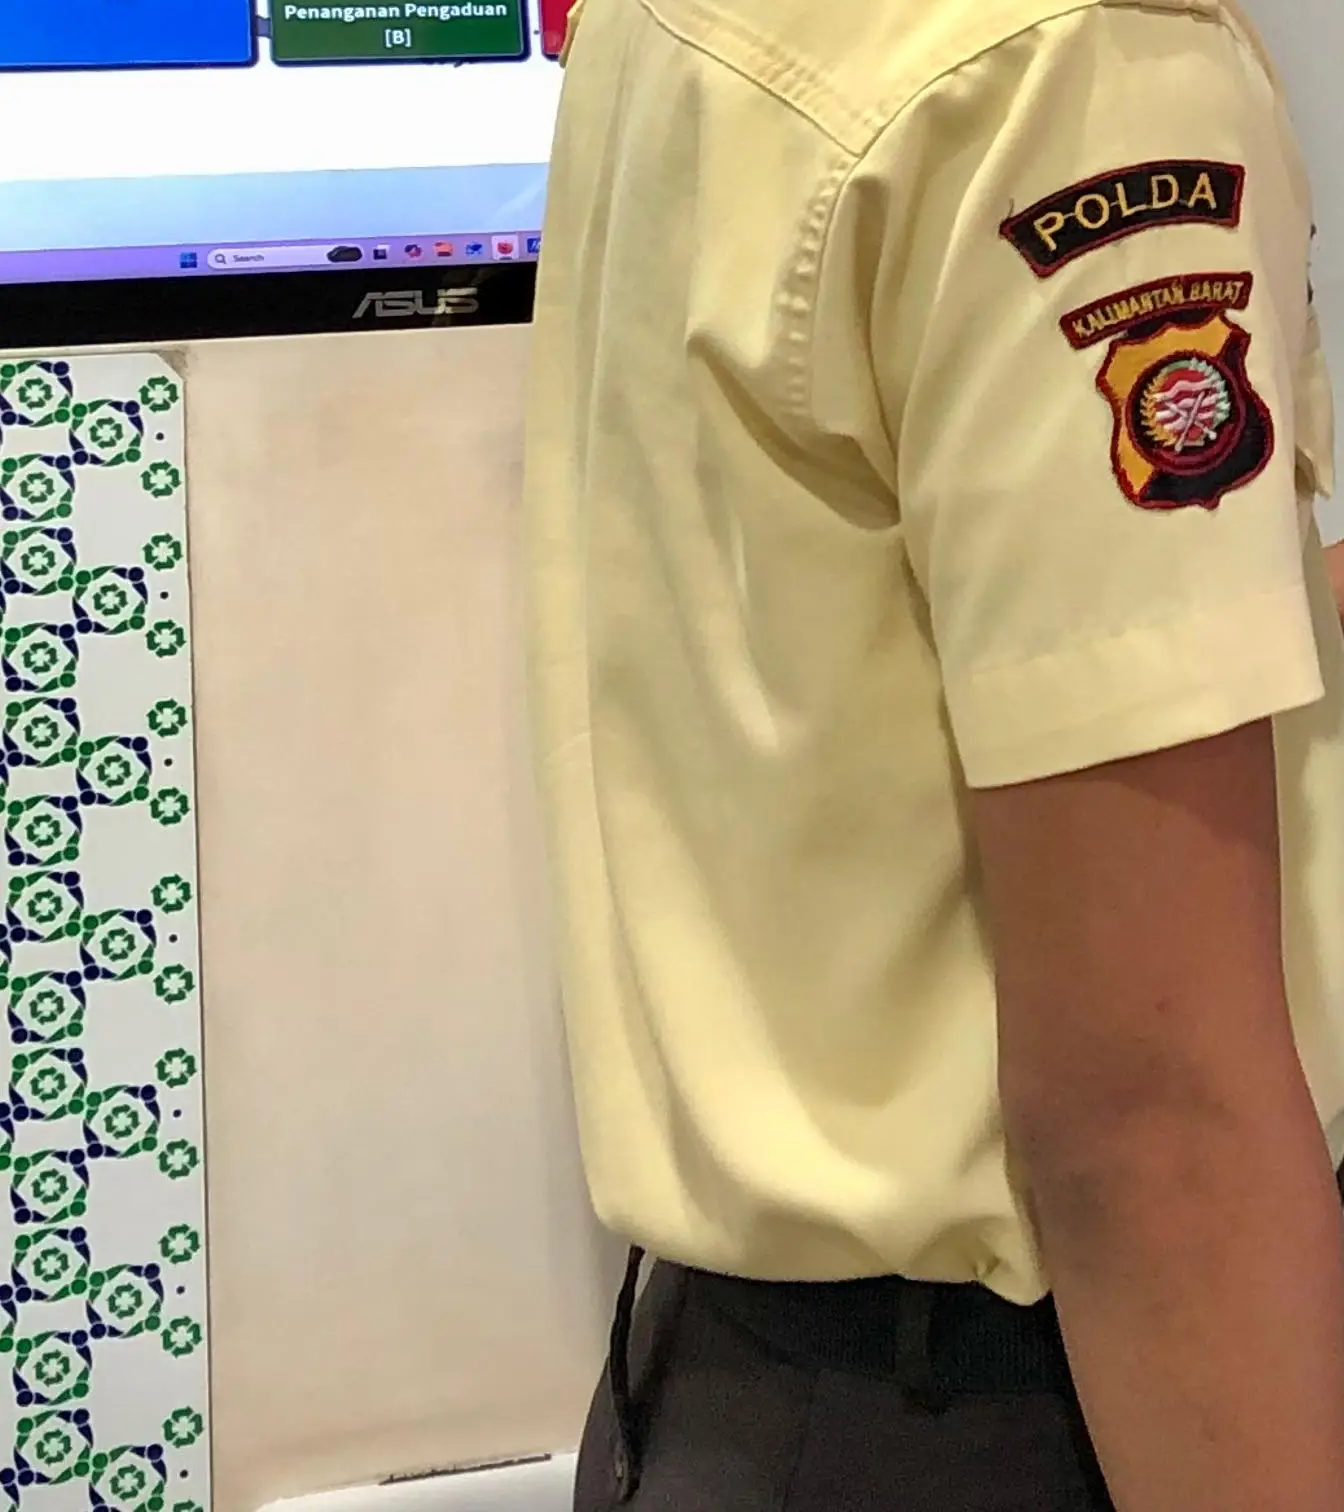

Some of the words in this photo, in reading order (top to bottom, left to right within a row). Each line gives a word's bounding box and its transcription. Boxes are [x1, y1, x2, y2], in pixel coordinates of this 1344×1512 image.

[284, 2, 400, 24] Penanganan
[404, 0, 508, 23] Pengaduan
[384, 27, 412, 49] [B]
[1034, 172, 1217, 252] POLDA
[352, 287, 480, 318] ASUS
